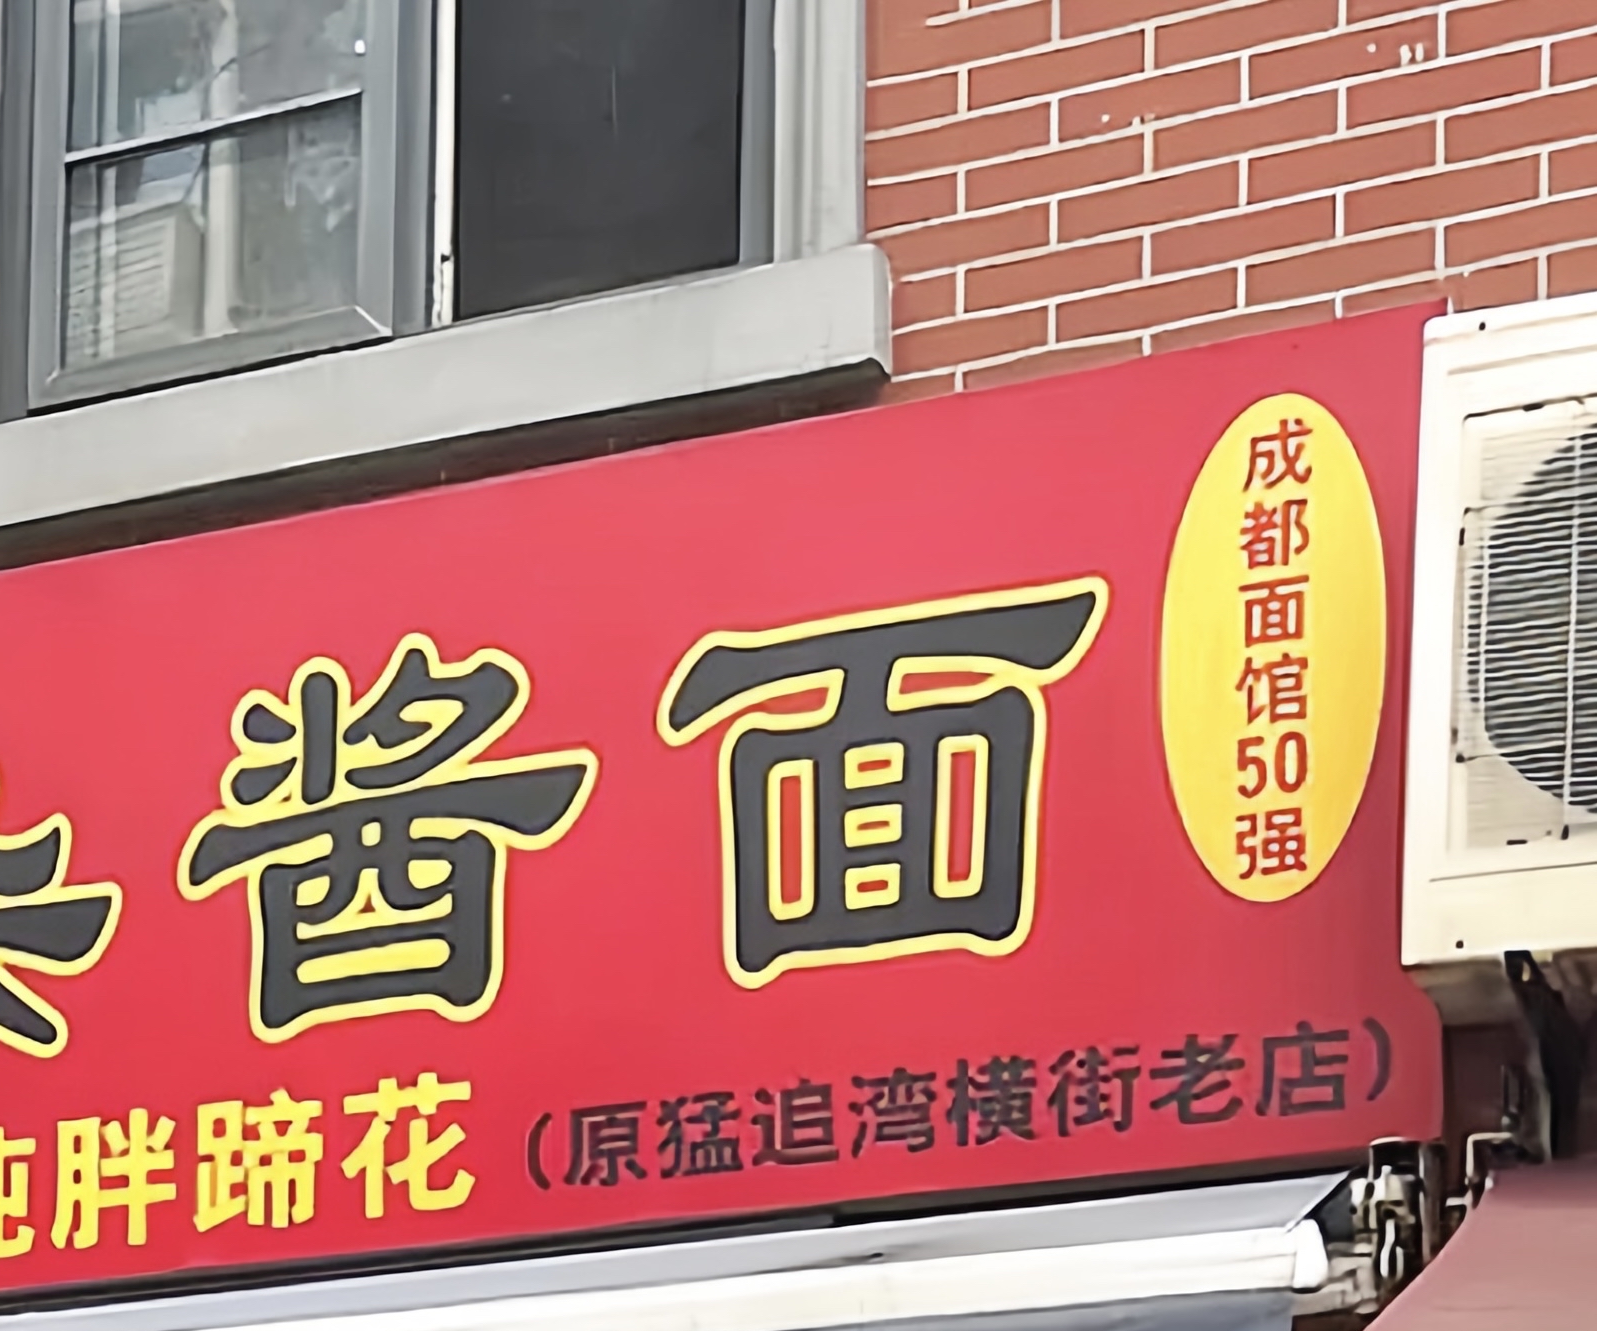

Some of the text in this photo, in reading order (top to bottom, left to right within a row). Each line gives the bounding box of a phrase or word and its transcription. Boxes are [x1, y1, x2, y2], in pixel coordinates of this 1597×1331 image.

[1235, 418, 1314, 880] 成都面馆50强
